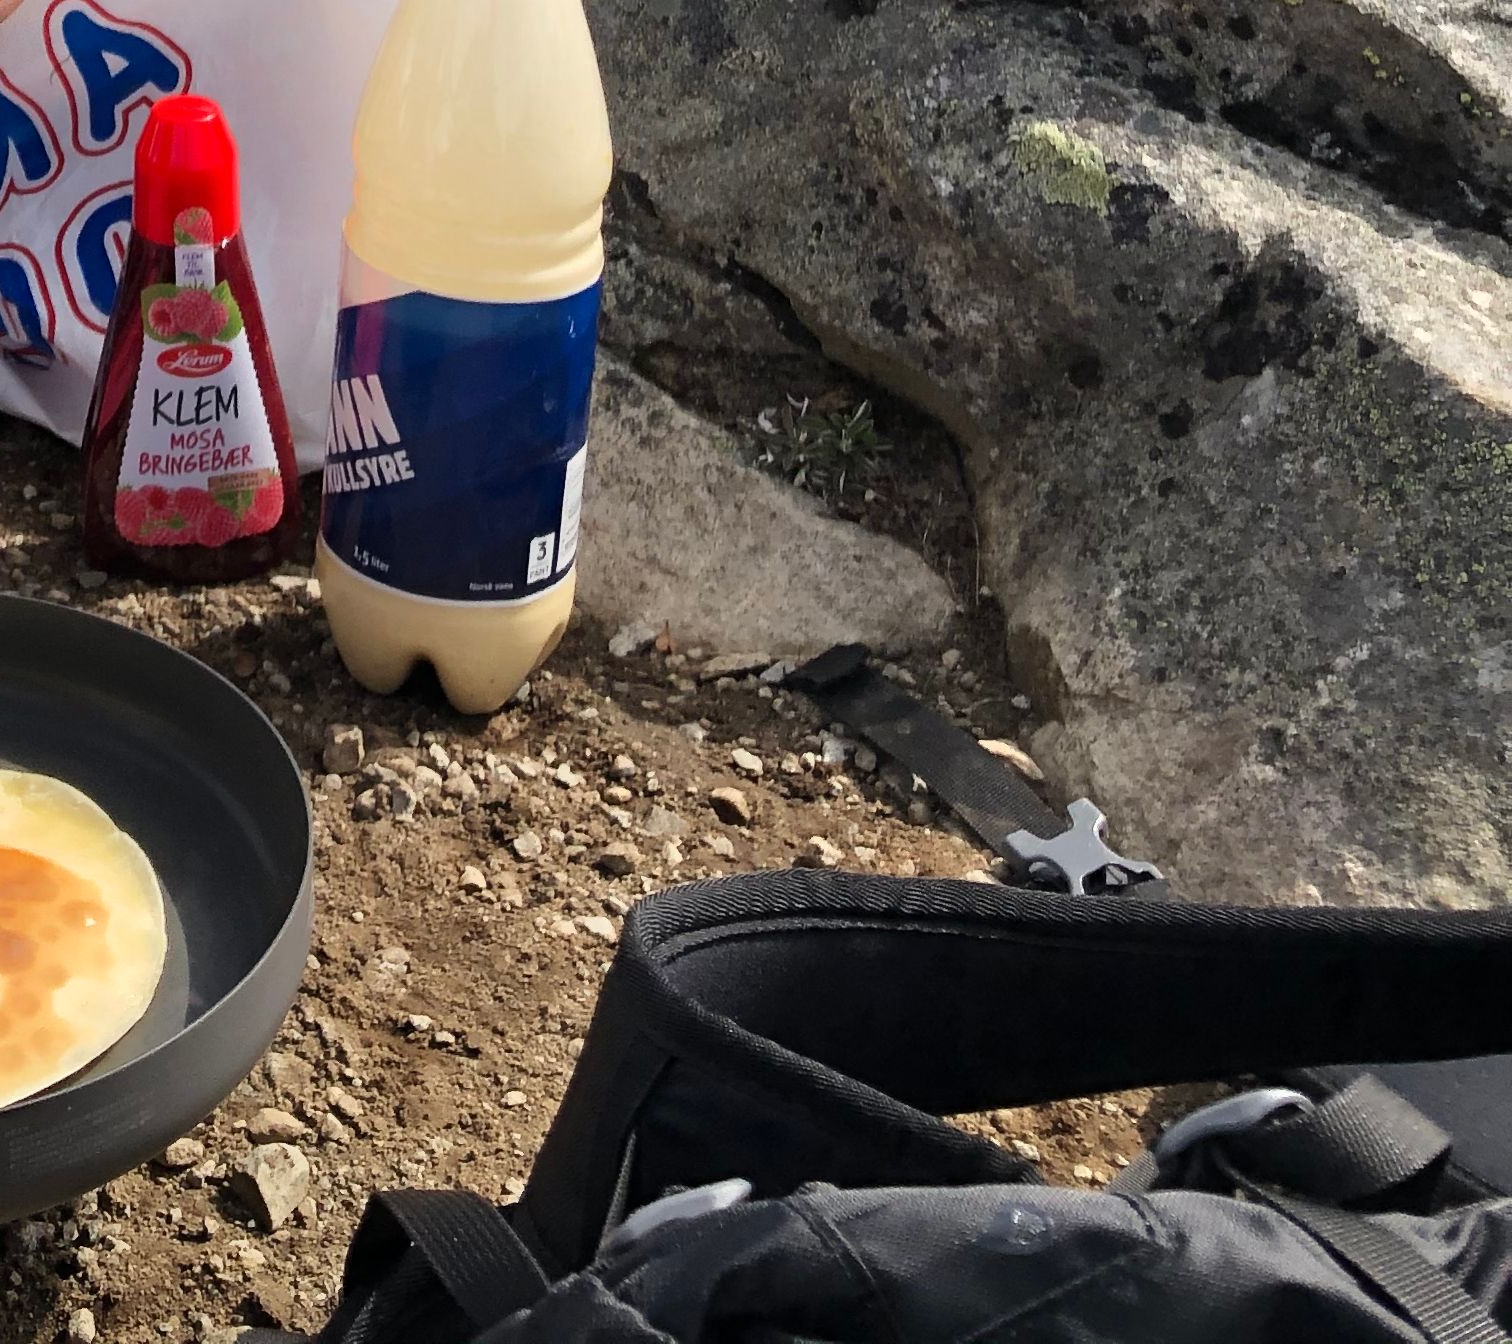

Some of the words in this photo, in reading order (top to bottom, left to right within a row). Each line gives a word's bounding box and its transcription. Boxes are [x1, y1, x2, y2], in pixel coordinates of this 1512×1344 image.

[162, 348, 225, 373] Lerum
[152, 384, 239, 427] KLEM
[170, 427, 225, 451] MOSA
[139, 444, 254, 476] BRINGEBÆR
[536, 540, 547, 561] 3
